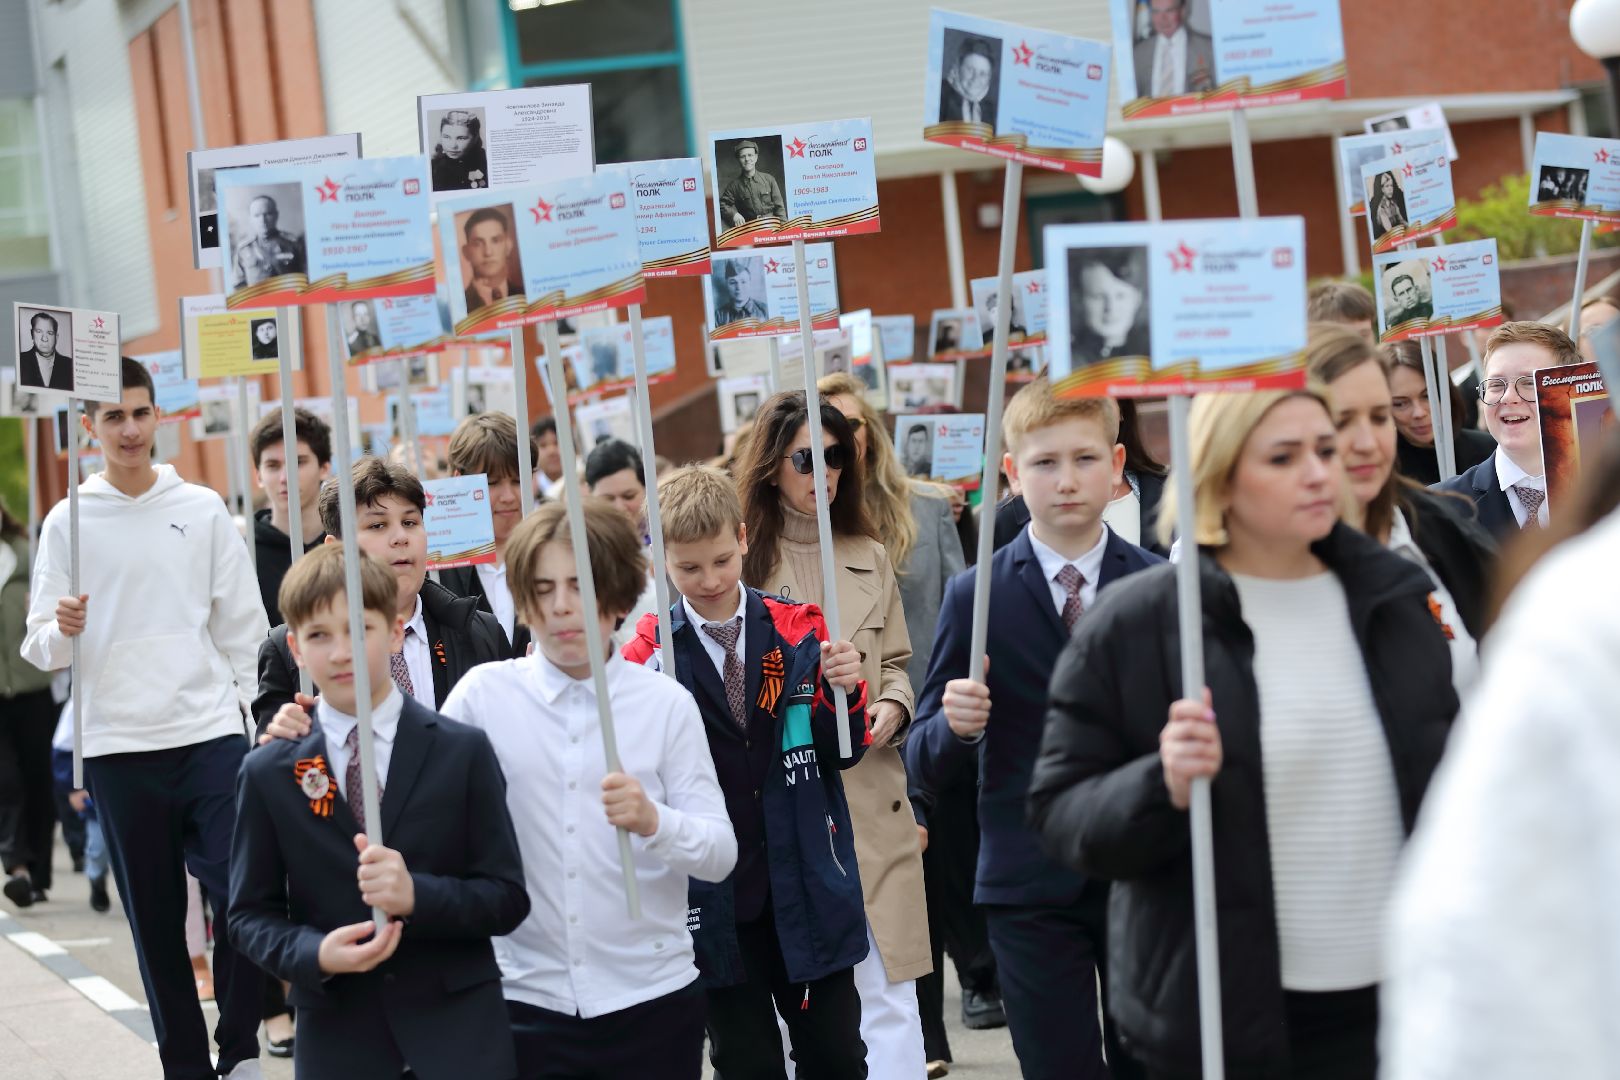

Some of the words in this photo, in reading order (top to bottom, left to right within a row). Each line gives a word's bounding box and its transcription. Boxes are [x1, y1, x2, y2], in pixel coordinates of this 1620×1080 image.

[809, 149, 833, 158] ПОЛК
[345, 192, 375, 201] ПОЛК
[636, 188, 661, 197] ПОЛК
[1575, 380, 1604, 394] ПОЛК
